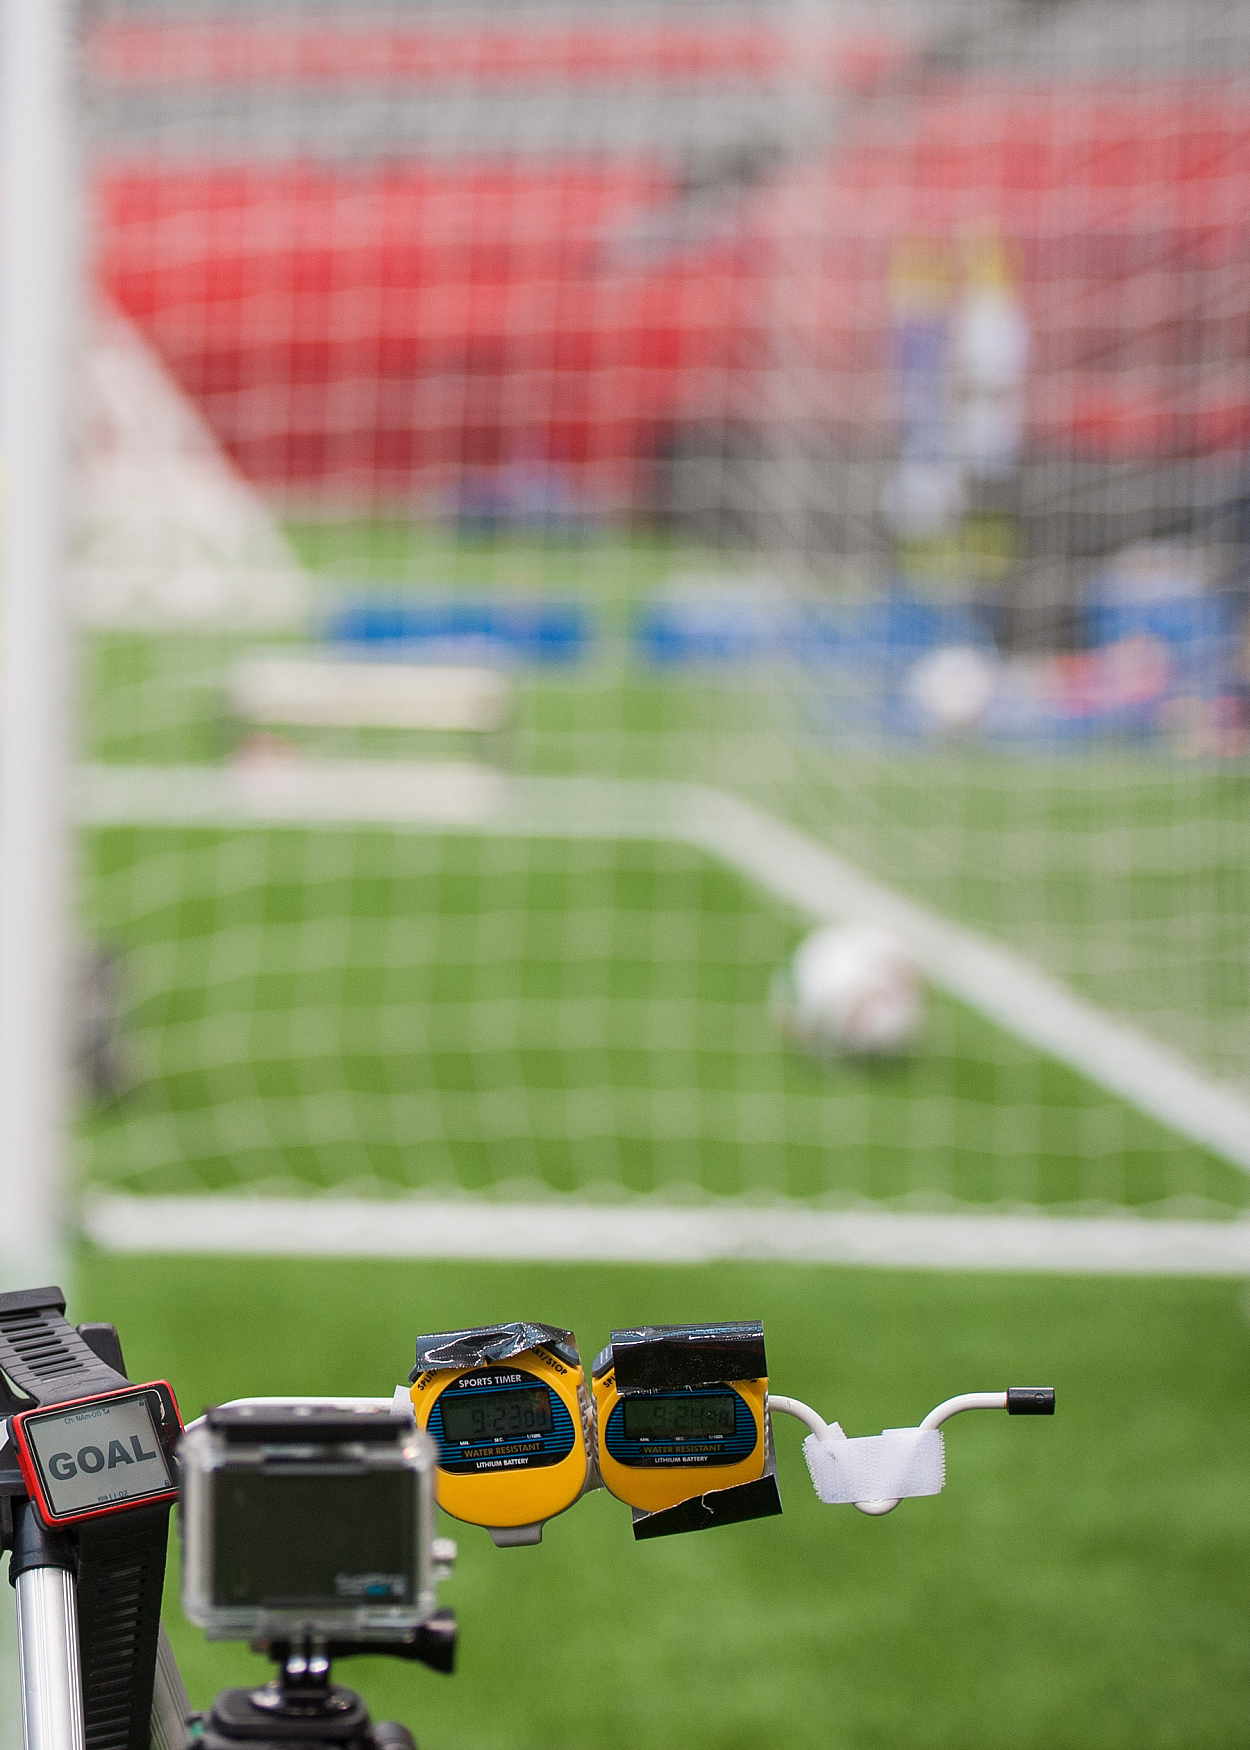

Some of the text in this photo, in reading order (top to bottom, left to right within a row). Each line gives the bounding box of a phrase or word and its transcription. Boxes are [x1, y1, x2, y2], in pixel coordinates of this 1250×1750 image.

[458, 1374, 522, 1388] SPORTS TIMER
[464, 1442, 540, 1458] WATER RESISTANT
[643, 1444, 722, 1454] WATER RESISTANT
[48, 1435, 157, 1481] GOAL
[476, 1457, 529, 1469] LITHIUM BATTERY
[682, 1455, 708, 1463] BATTERY
